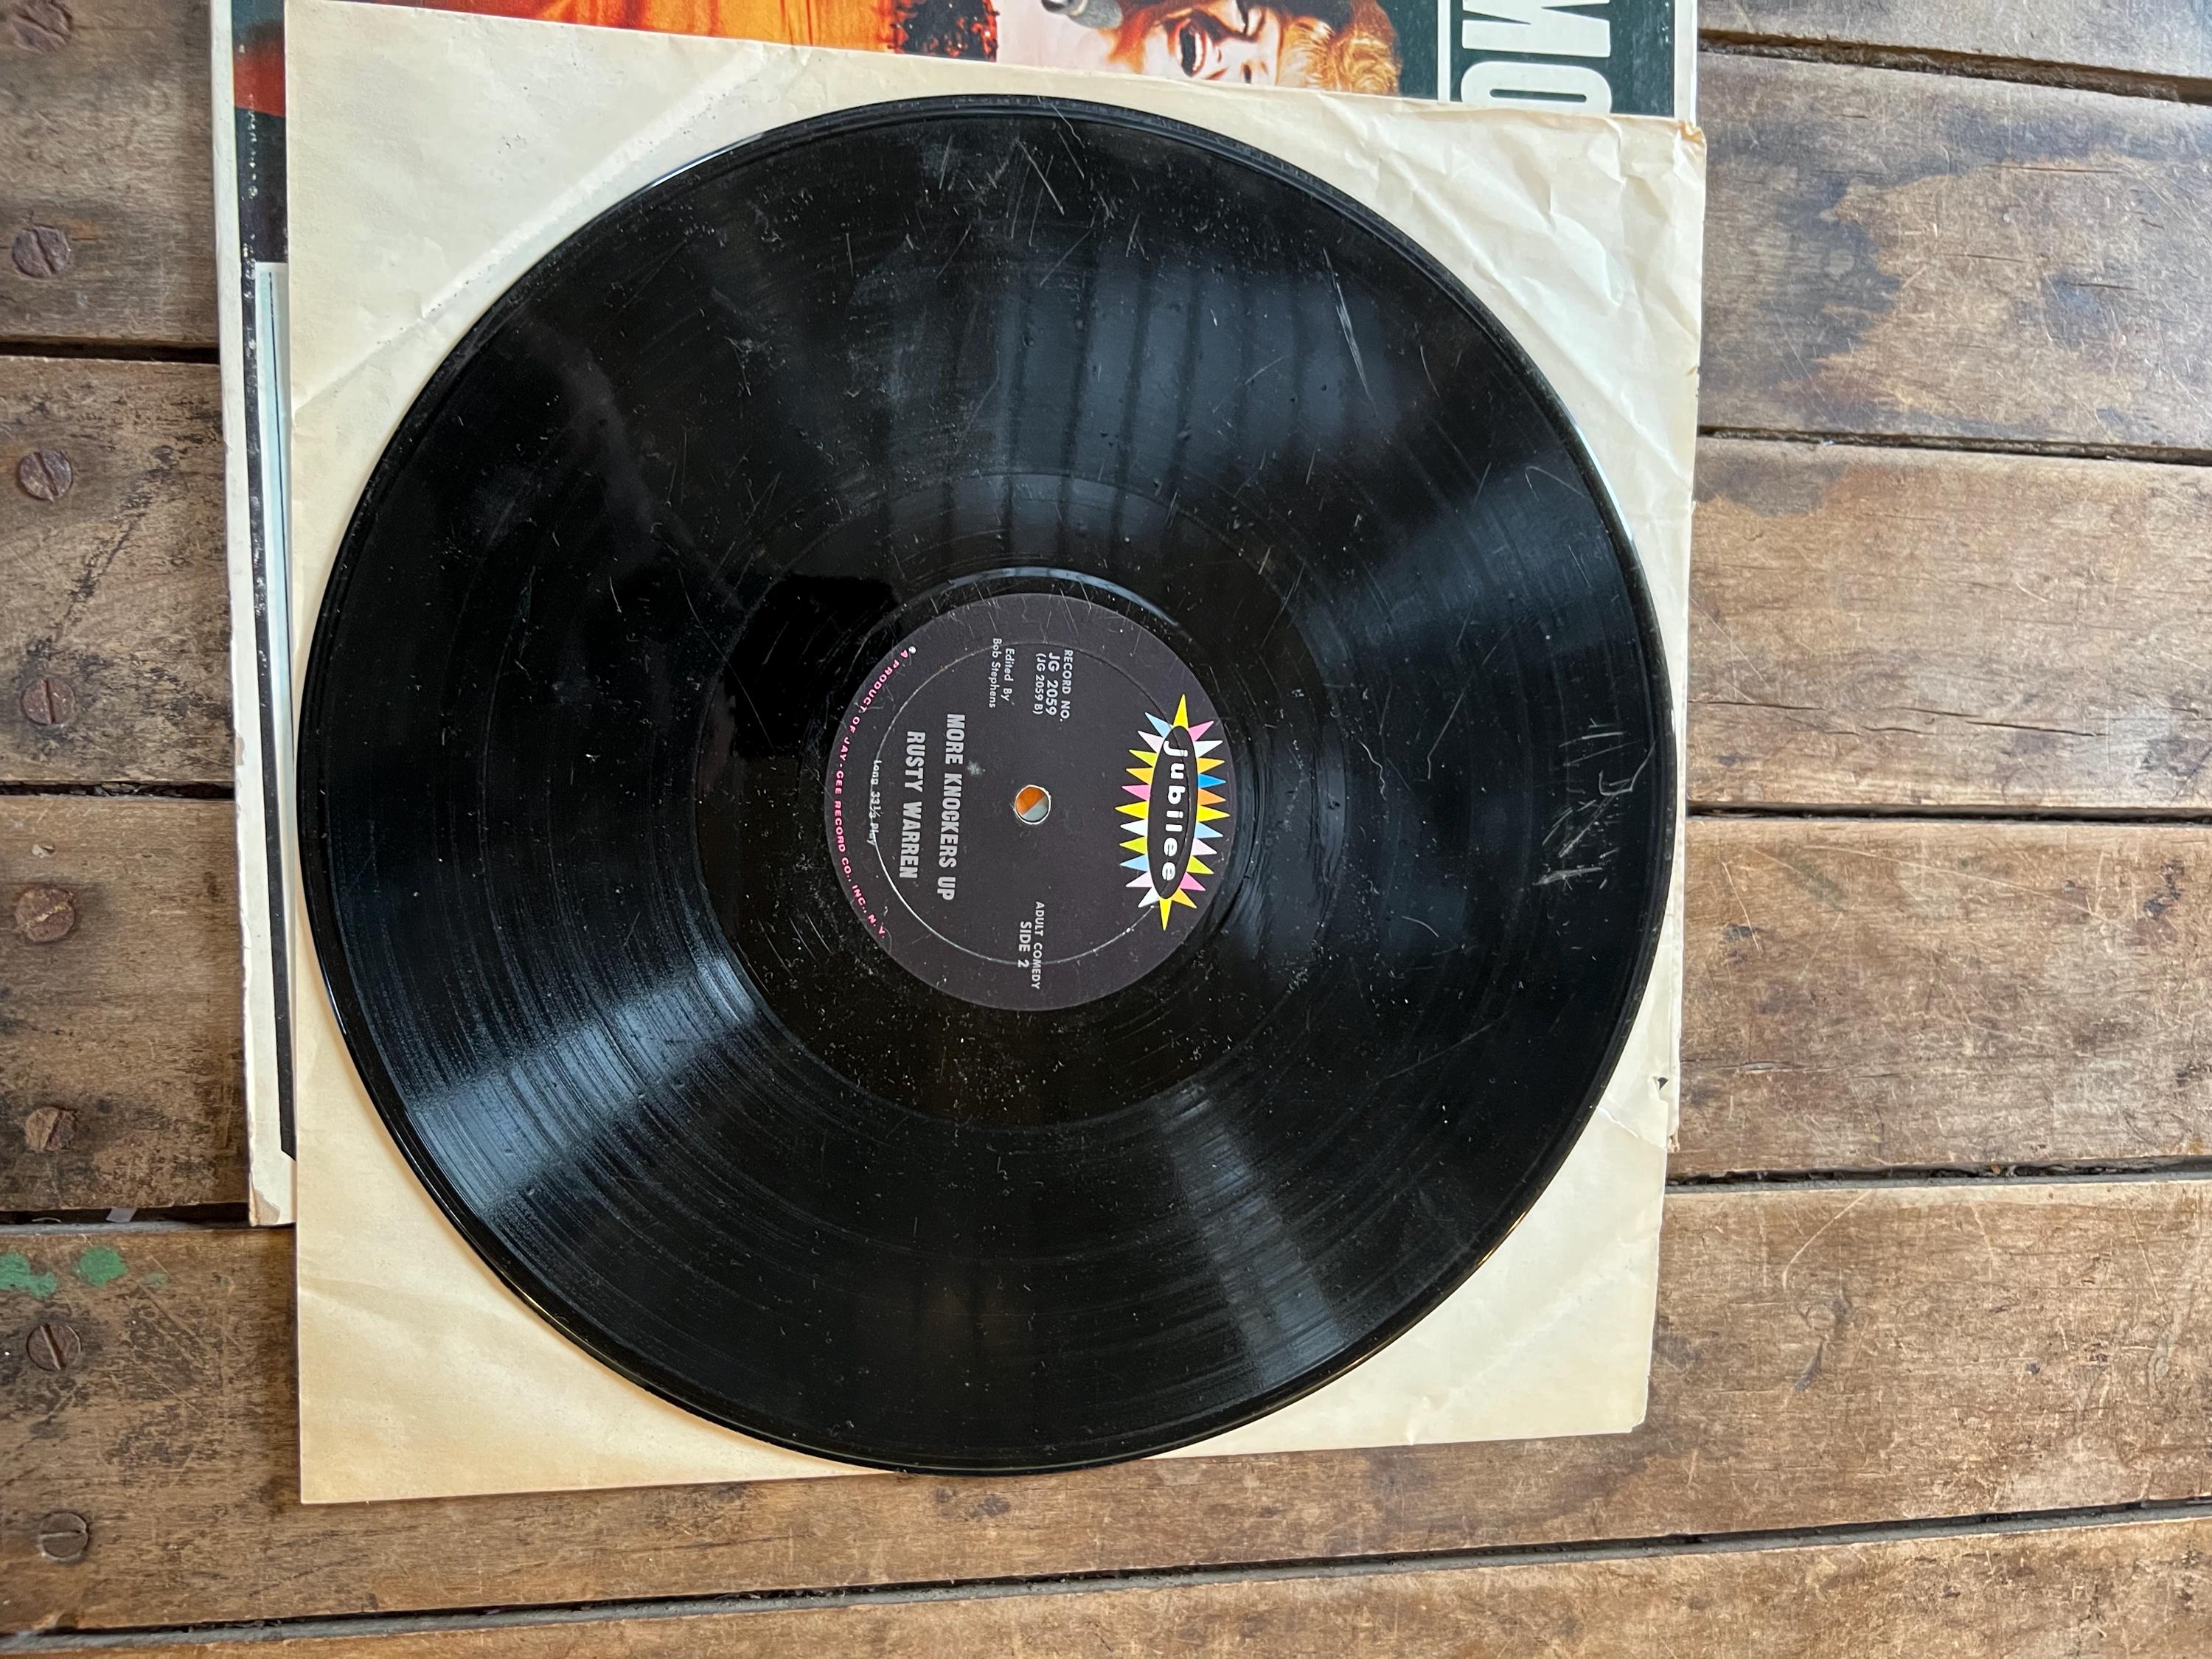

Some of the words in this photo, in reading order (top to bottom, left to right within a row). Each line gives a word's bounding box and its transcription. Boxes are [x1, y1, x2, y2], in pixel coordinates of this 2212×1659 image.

[900, 649, 908, 658] A
[992, 638, 1003, 658] Bob
[1035, 653, 1047, 672] (JG
[1048, 652, 1061, 672] JG
[1004, 648, 1015, 682] Edited
[1062, 649, 1074, 695] RECORD
[859, 659, 900, 713] PRODUCT
[988, 661, 1001, 709] Stephens
[1001, 687, 1012, 702] By
[1034, 674, 1045, 701] 2059
[1046, 679, 1059, 716] 2059
[1032, 703, 1043, 714] B)
[1060, 700, 1071, 722] NO.
[849, 716, 860, 734] OF
[945, 713, 966, 765] MORE
[870, 759, 882, 785] Long
[904, 731, 926, 793] RUSTY
[834, 800, 846, 853] RECORD
[938, 772, 962, 869] KNOCKERS
[1161, 740, 1189, 882] jubilee
[899, 801, 922, 879] WARREN
[936, 876, 956, 901] UP
[1034, 901, 1046, 937] ADULT
[1018, 921, 1032, 952] SIDE
[1018, 959, 1030, 968] 2
[1031, 942, 1043, 990] COMEDY
